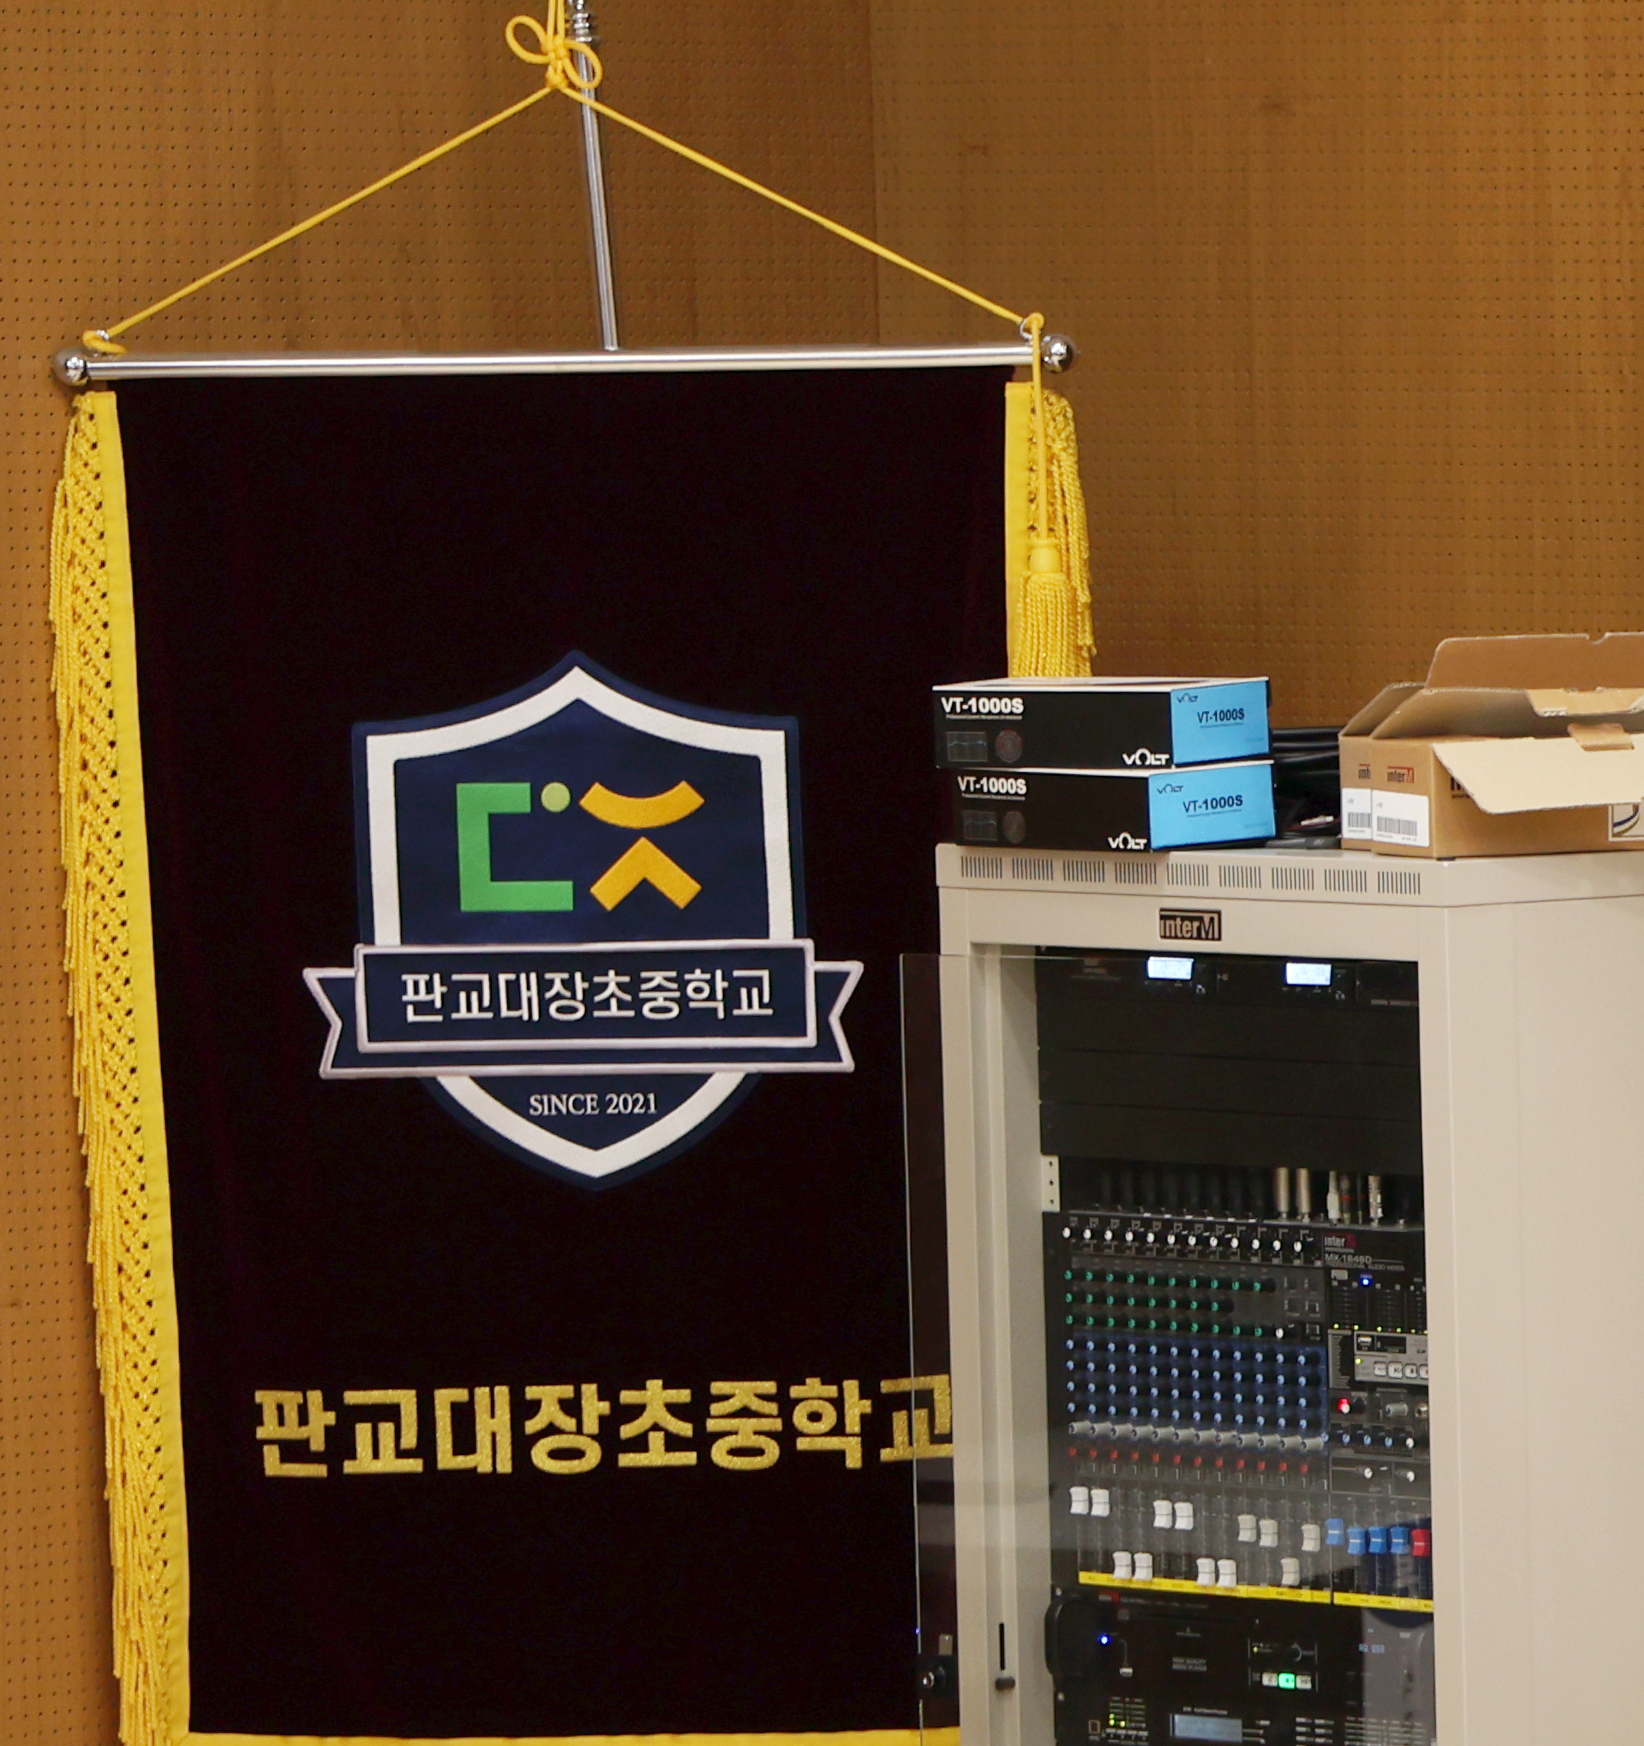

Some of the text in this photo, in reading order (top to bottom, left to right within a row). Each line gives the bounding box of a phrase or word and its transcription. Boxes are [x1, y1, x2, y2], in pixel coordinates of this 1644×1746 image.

[941, 696, 1025, 714] VT-1000S
[1197, 707, 1245, 724] VT-1000S
[957, 776, 1028, 795] VT-1000S
[1183, 794, 1244, 814] VT-1000S
[400, 967, 775, 1024] 판교대장초중학교
[529, 1092, 658, 1118] SINCE 2021
[254, 1375, 954, 1478] 판교대장초중학교
